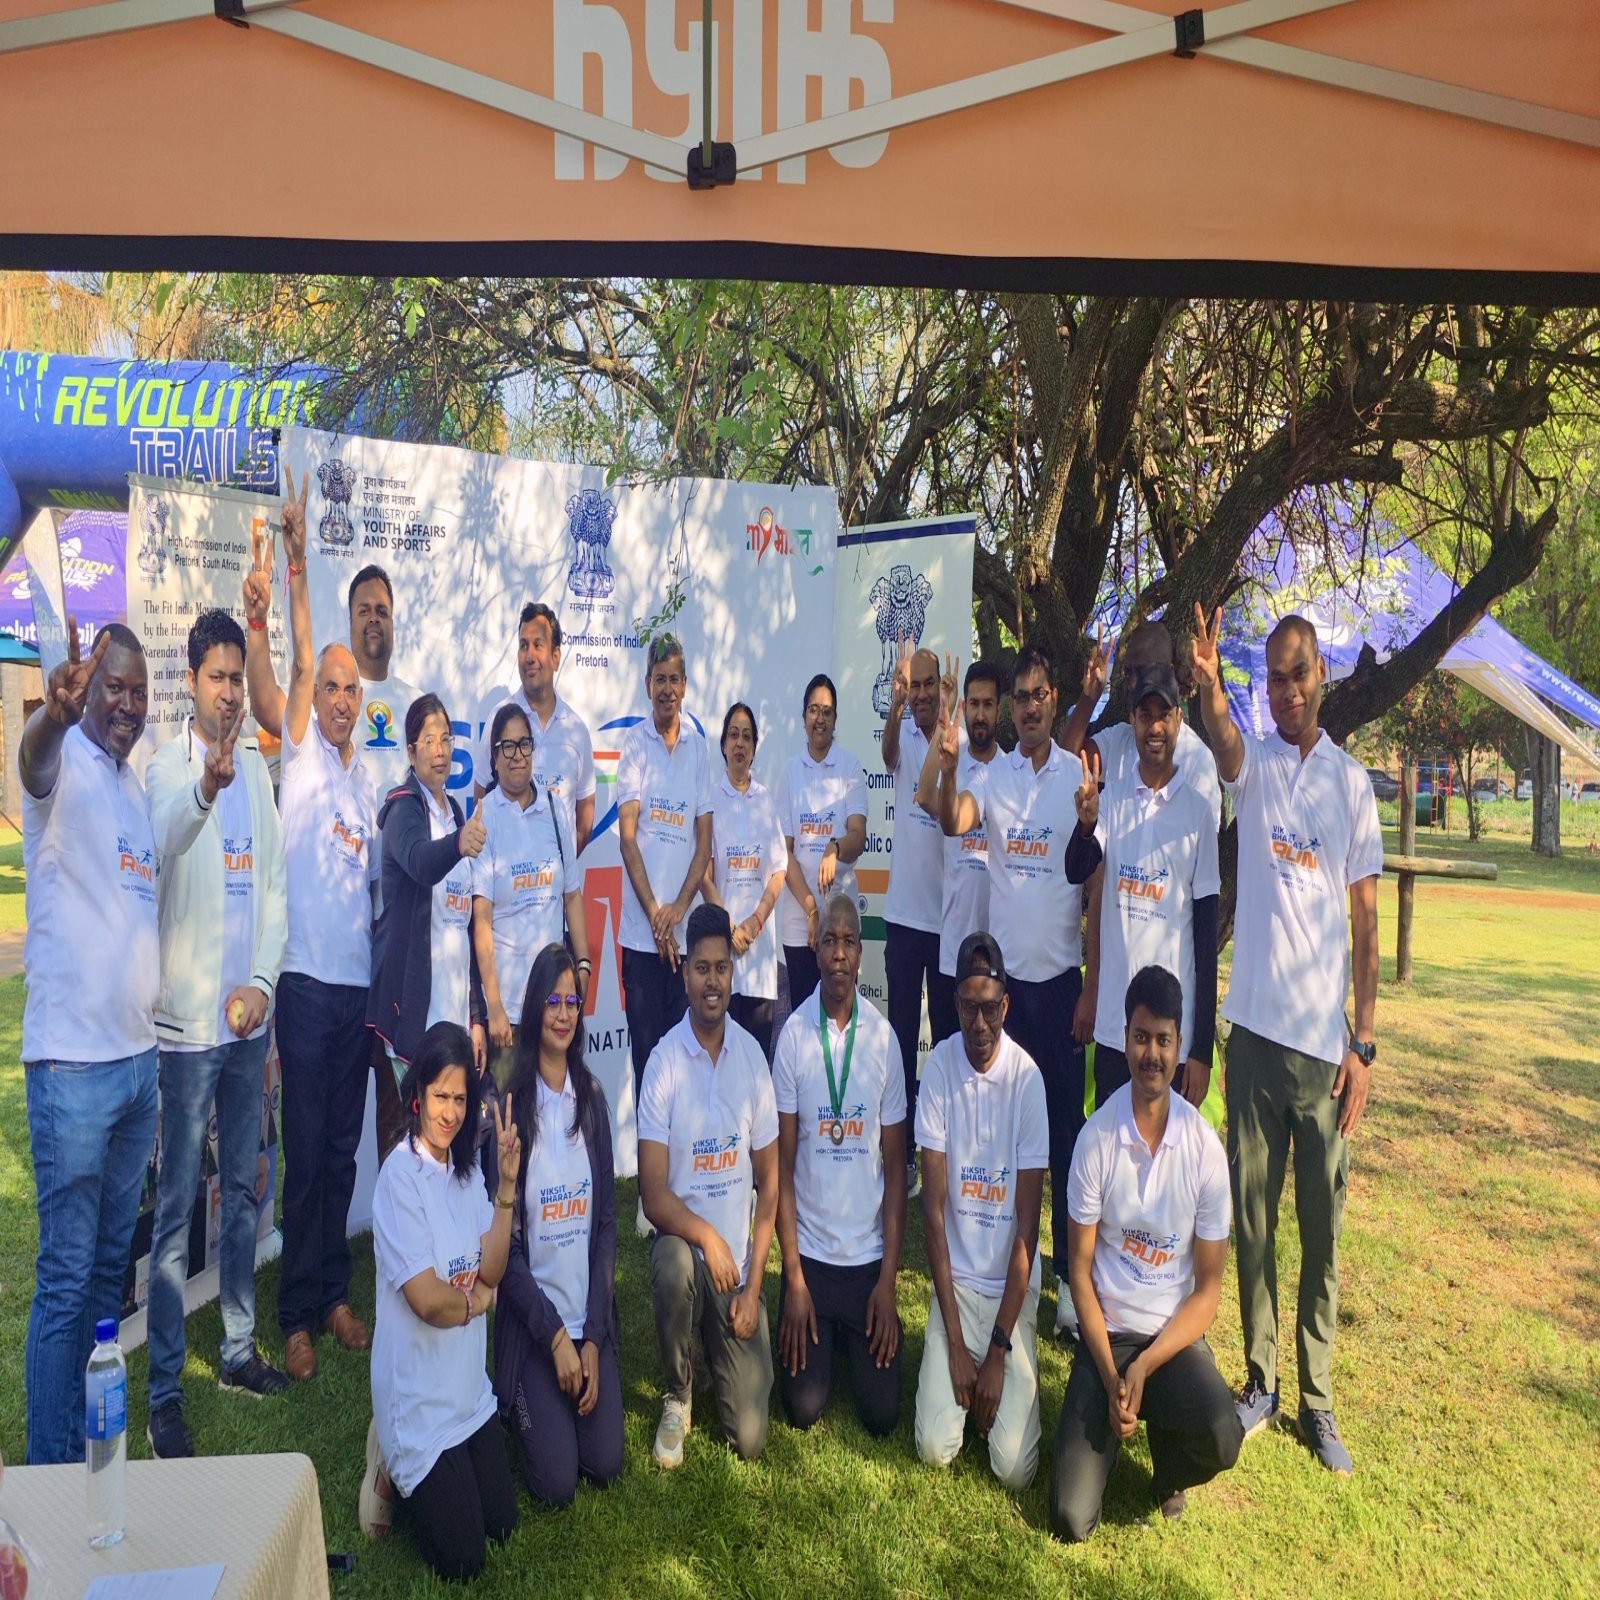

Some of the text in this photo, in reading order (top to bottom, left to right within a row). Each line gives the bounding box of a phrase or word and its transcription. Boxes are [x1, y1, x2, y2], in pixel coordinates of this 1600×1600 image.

[53, 376, 322, 428] REVOLUTION
[130, 427, 277, 485] TRAILS
[363, 476, 376, 489] युवा
[363, 506, 421, 521] MINISTRY OF
[363, 520, 446, 538] YOUTH AFFAIRS
[168, 535, 247, 555] High Commission of India
[363, 535, 431, 552] AND SPORTS
[202, 556, 220, 569] South
[221, 558, 240, 571] Africa
[144, 600, 160, 614] The
[162, 600, 173, 614] Fit
[175, 601, 193, 615] India
[143, 622, 154, 639] by
[156, 622, 169, 636] the
[561, 633, 612, 648] Commission
[613, 634, 623, 647] of
[142, 644, 178, 658] Narendra
[576, 653, 608, 668] Pretoria
[153, 670, 163, 680] an
[153, 688, 174, 704] bring
[146, 709, 161, 724] and
[163, 708, 179, 723] lead
[650, 809, 685, 827] RUN
[801, 823, 833, 836] RUN
[1007, 827, 1030, 835] VIKSIT
[1007, 833, 1034, 841] BHARAT
[1007, 840, 1048, 857] RUN
[1272, 841, 1317, 870] RUN
[120, 853, 152, 883] RUN
[728, 856, 760, 869] RUN
[1120, 863, 1144, 875] VIKSIT
[513, 871, 553, 891] RUN
[1119, 869, 1149, 882] BHARAT
[1117, 877, 1164, 901] RUN
[589, 1029, 630, 1053] NATI
[819, 1120, 863, 1136] RN
[692, 1138, 717, 1148] VIKSIT
[692, 1145, 722, 1155] BHARAT
[693, 1151, 738, 1172] RUN
[961, 1166, 986, 1175] VIKSIT
[961, 1173, 992, 1184] BHARAT
[540, 1184, 566, 1196] VIKSIT
[540, 1191, 572, 1204] BHARAT
[961, 1181, 1006, 1202] RUN
[542, 1198, 588, 1222] RUN
[1122, 1228, 1151, 1238] VIKSIT
[1122, 1237, 1175, 1267] RUN
